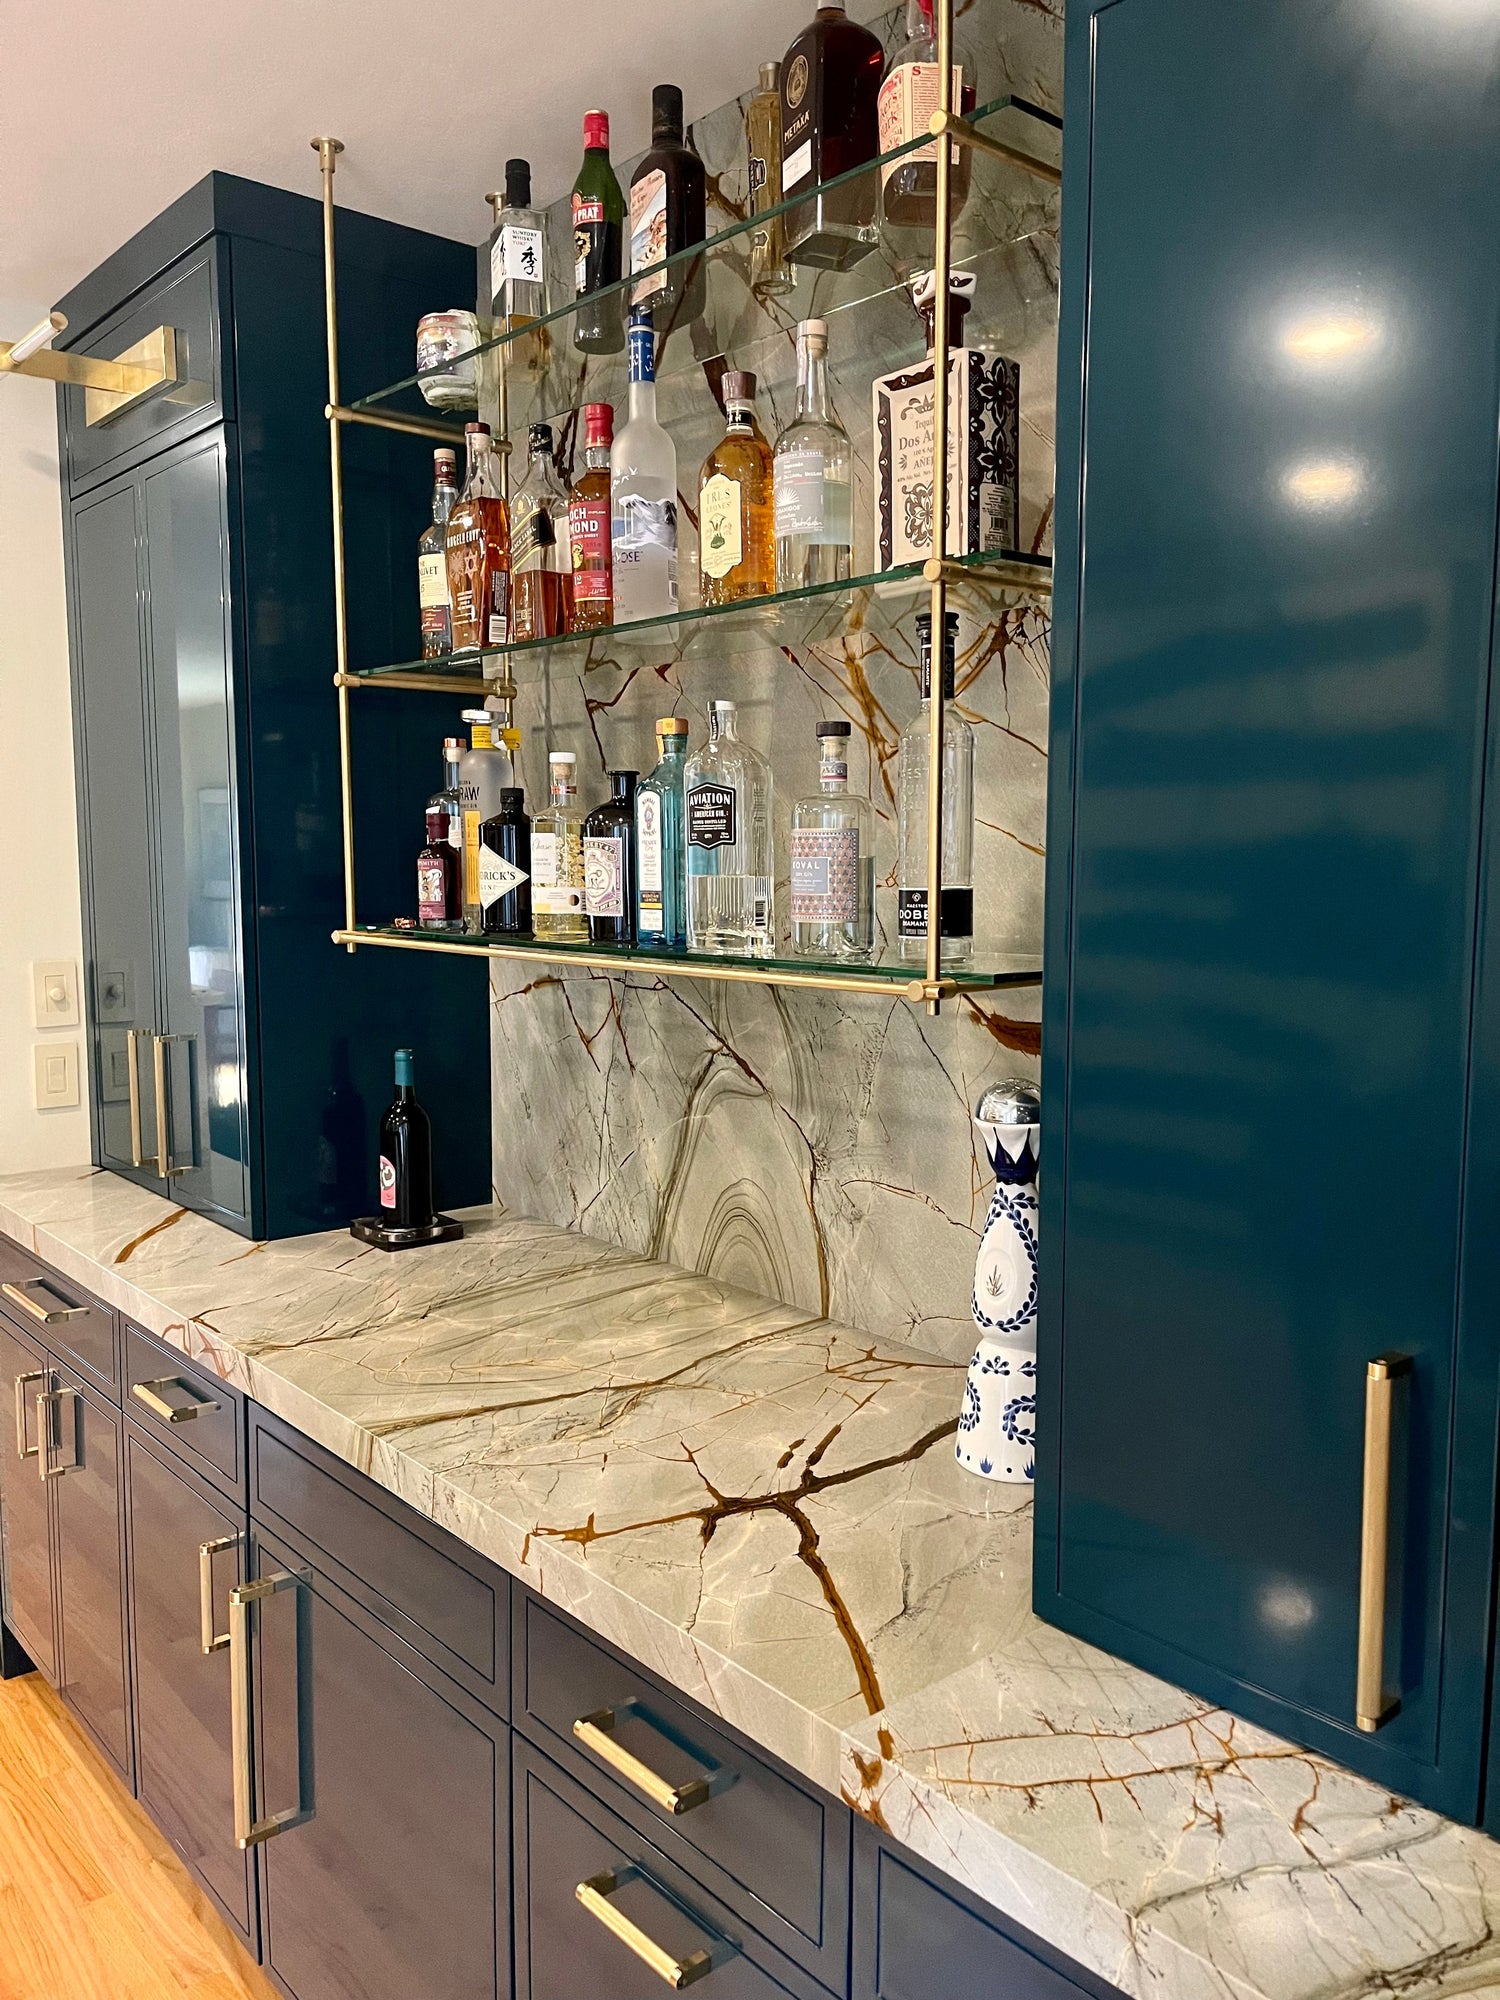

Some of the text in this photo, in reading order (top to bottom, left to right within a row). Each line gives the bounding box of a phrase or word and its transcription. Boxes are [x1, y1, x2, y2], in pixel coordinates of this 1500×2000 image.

[784, 110, 810, 142] METAXA
[577, 206, 599, 221] PRAT
[915, 415, 935, 431] Tequil
[898, 435, 921, 451] Dos
[569, 507, 587, 521] OCH
[569, 520, 599, 534] MOND
[689, 792, 731, 807] AVIATION
[480, 871, 516, 881] DRICK'S
[900, 909, 928, 920] DOBE
